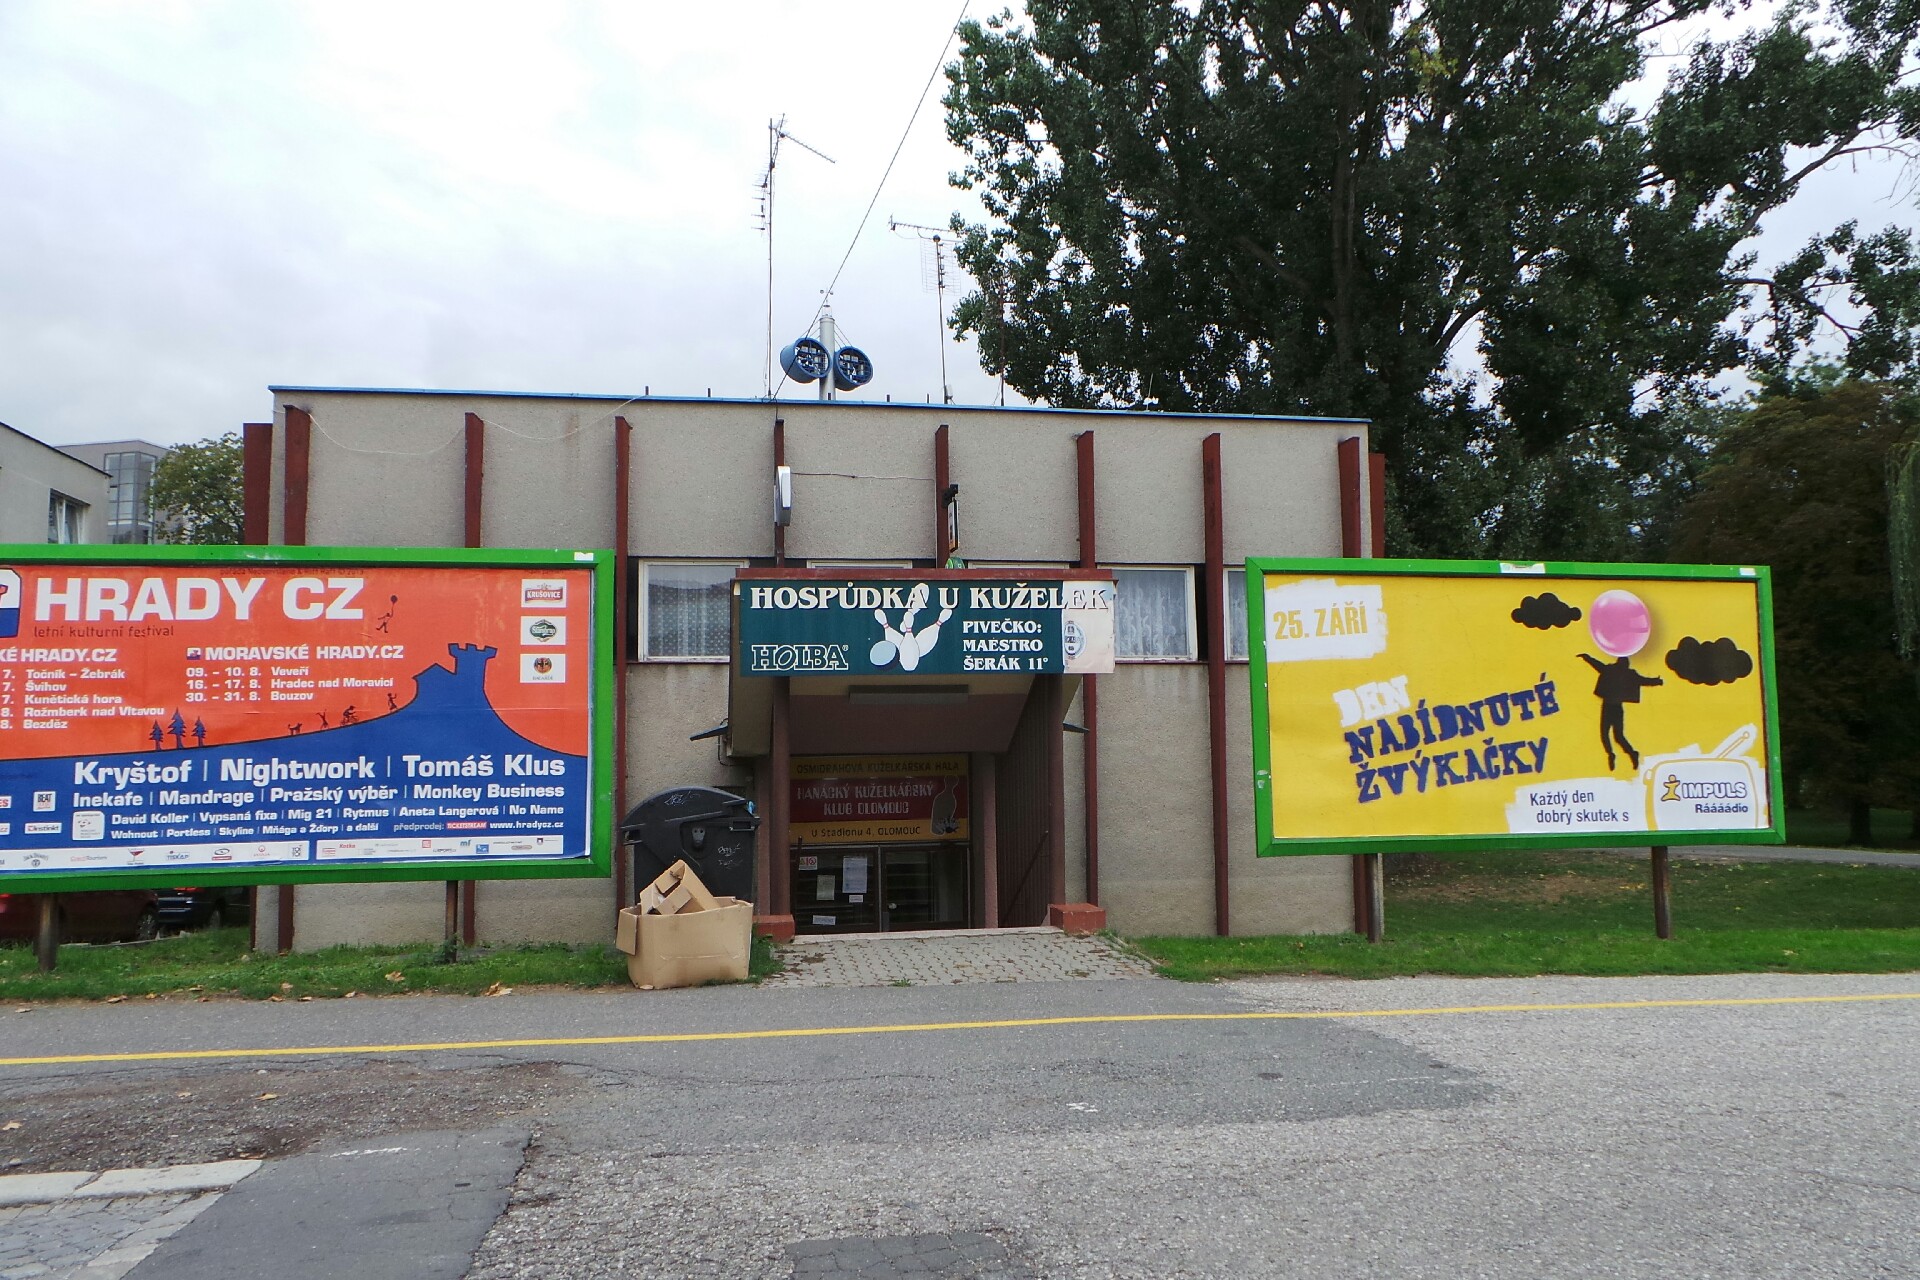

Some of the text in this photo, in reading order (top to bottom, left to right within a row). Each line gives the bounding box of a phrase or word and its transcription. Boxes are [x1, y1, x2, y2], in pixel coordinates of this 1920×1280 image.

[35, 577, 364, 622] HRADY CZ
[750, 581, 928, 610] HOSPŮDKA
[938, 587, 960, 610] U
[962, 617, 1042, 634] PIVEČKO:
[1273, 601, 1368, 640] 25. ZÁŘÍ
[34, 625, 175, 638] letní kulturní festival
[205, 643, 404, 661] MORAVSKÉ HRADY.CZ
[962, 639, 1044, 652] MAESTRO
[21, 648, 117, 663] HRADY.CZ
[963, 654, 1021, 671] ŠERÁK
[2, 669, 16, 679] 7.
[25, 668, 66, 679] Točník
[79, 667, 125, 679] Žebrák
[185, 667, 208, 678] 09.
[224, 666, 245, 677] 10.
[249, 666, 262, 677] 8.
[270, 666, 309, 677] Veveří
[2, 679, 67, 692] 7. Švihov
[186, 679, 208, 690] 16.
[224, 679, 245, 689] 17.
[249, 679, 262, 689] 8.
[270, 678, 315, 689] Hradec
[318, 677, 340, 688] nad
[342, 677, 394, 688] Moravicí
[1, 693, 123, 705] 7. Kunětická hora
[186, 692, 208, 703] 30.
[223, 691, 245, 702] 31.
[249, 691, 261, 701] 8.
[270, 691, 314, 701] Bouzov
[1332, 675, 1411, 728] DEN
[0, 706, 165, 718] 8. Rožmberk nad Vltavou
[1344, 672, 1560, 764] NABÍDNUTÉ
[0, 718, 69, 730] 8. Bezděz
[74, 754, 566, 791] Kryštof Nightwork Tomáš Klus
[1356, 737, 1549, 804] ŽVÝKAČKY
[73, 783, 565, 808] Inekafe Mandrage Pražský výběr Monkey Business
[855, 781, 935, 799] KUŽELKÁŘSKÝ
[1530, 789, 1594, 808] Každý den
[1682, 782, 1748, 799] IMPULS
[111, 804, 564, 825] David Koller Vypsaná fixa Mig 21 Rytmus Aneta Langerová No Name
[823, 801, 909, 816] KLUB OLOMOUC
[1536, 807, 1630, 826] dobrý skutek s
[111, 829, 159, 840] Wohnout
[166, 828, 211, 838] Portless
[219, 826, 255, 838] Skyline
[262, 825, 298, 837] Mňága
[299, 826, 307, 834] a
[346, 824, 353, 832] a
[355, 823, 379, 832] další
[393, 822, 444, 832] předprodej:
[489, 820, 564, 830] www.hradycz.cz
[811, 829, 818, 837] U
[821, 828, 863, 838] Stadionu
[877, 826, 921, 836] OLOMOUC
